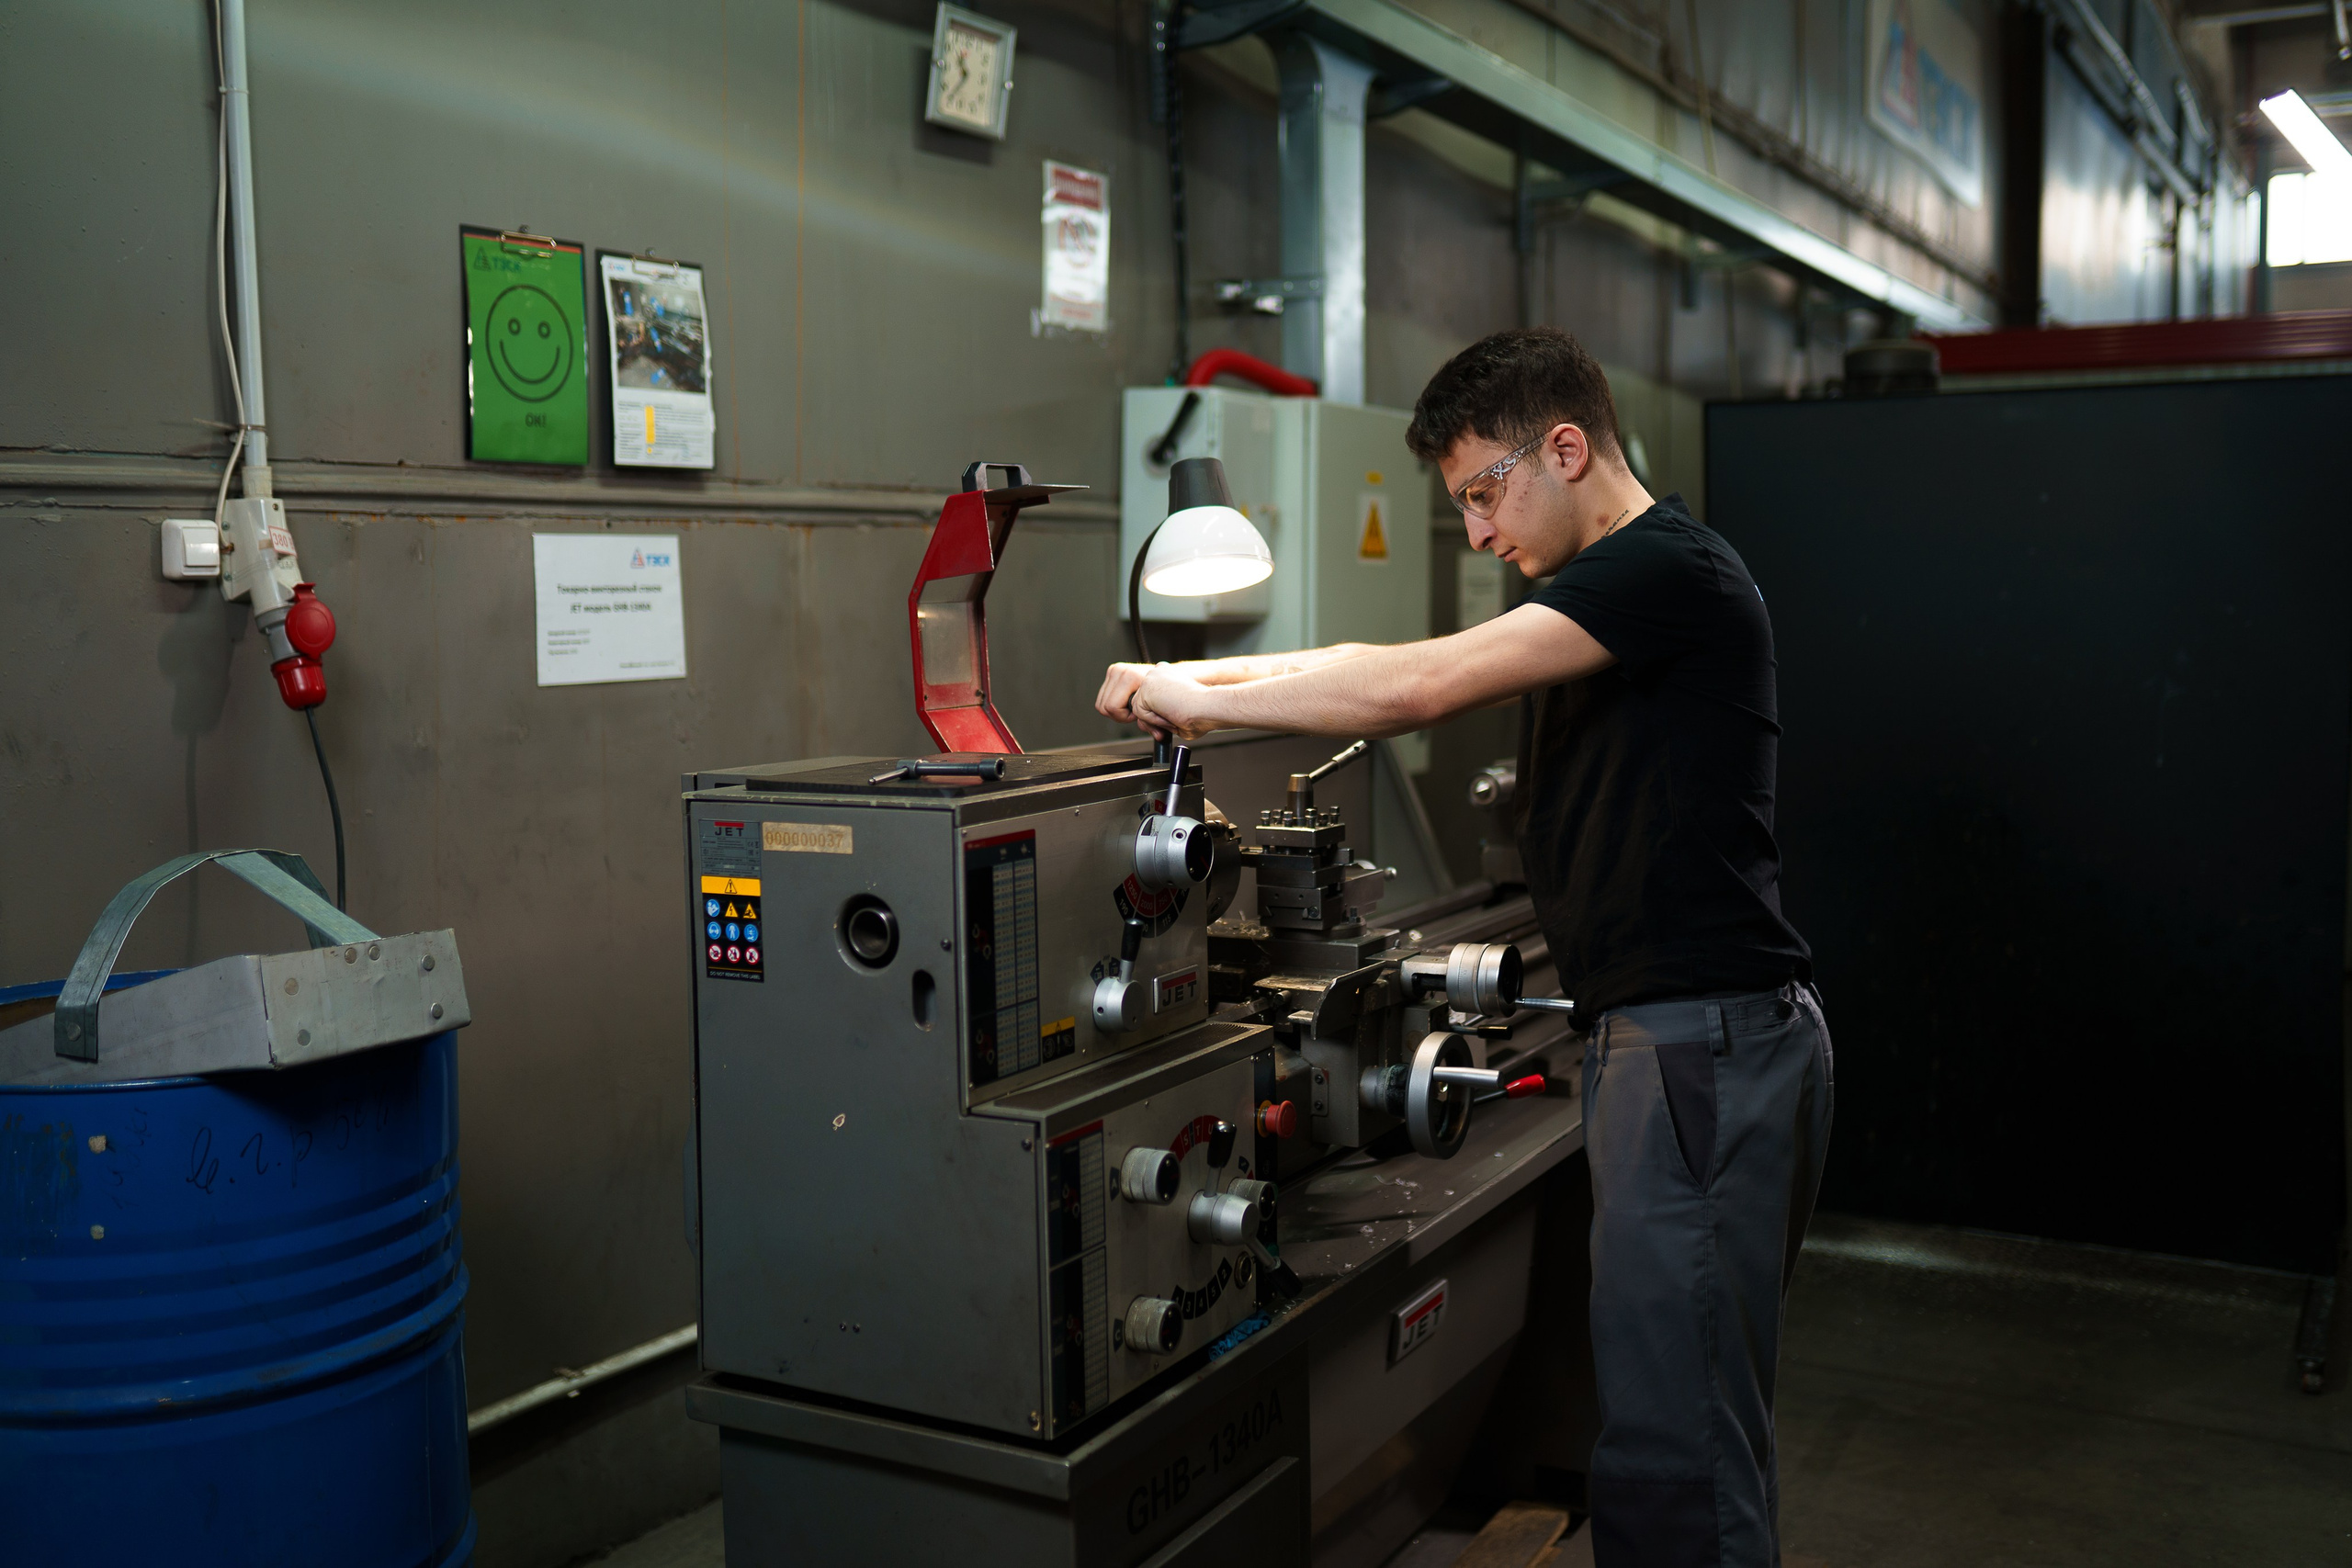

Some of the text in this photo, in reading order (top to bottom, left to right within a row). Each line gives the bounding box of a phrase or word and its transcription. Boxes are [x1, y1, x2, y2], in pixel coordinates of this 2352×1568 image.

[273, 533, 288, 548] 380
[715, 827, 744, 837] JET
[1127, 879, 1138, 900] 1250
[1119, 898, 1129, 916] 190
[1140, 899, 1154, 911] 2000
[1160, 914, 1172, 927] 115
[1162, 980, 1197, 1007] JET
[1182, 1134, 1189, 1146] S
[1195, 1125, 1201, 1136] T
[1185, 1300, 1192, 1314] 3
[1199, 1296, 1204, 1308] 4
[1221, 1268, 1227, 1280] 2
[1403, 1303, 1443, 1349] JET
[1126, 1386, 1283, 1535] GHB-1340A
